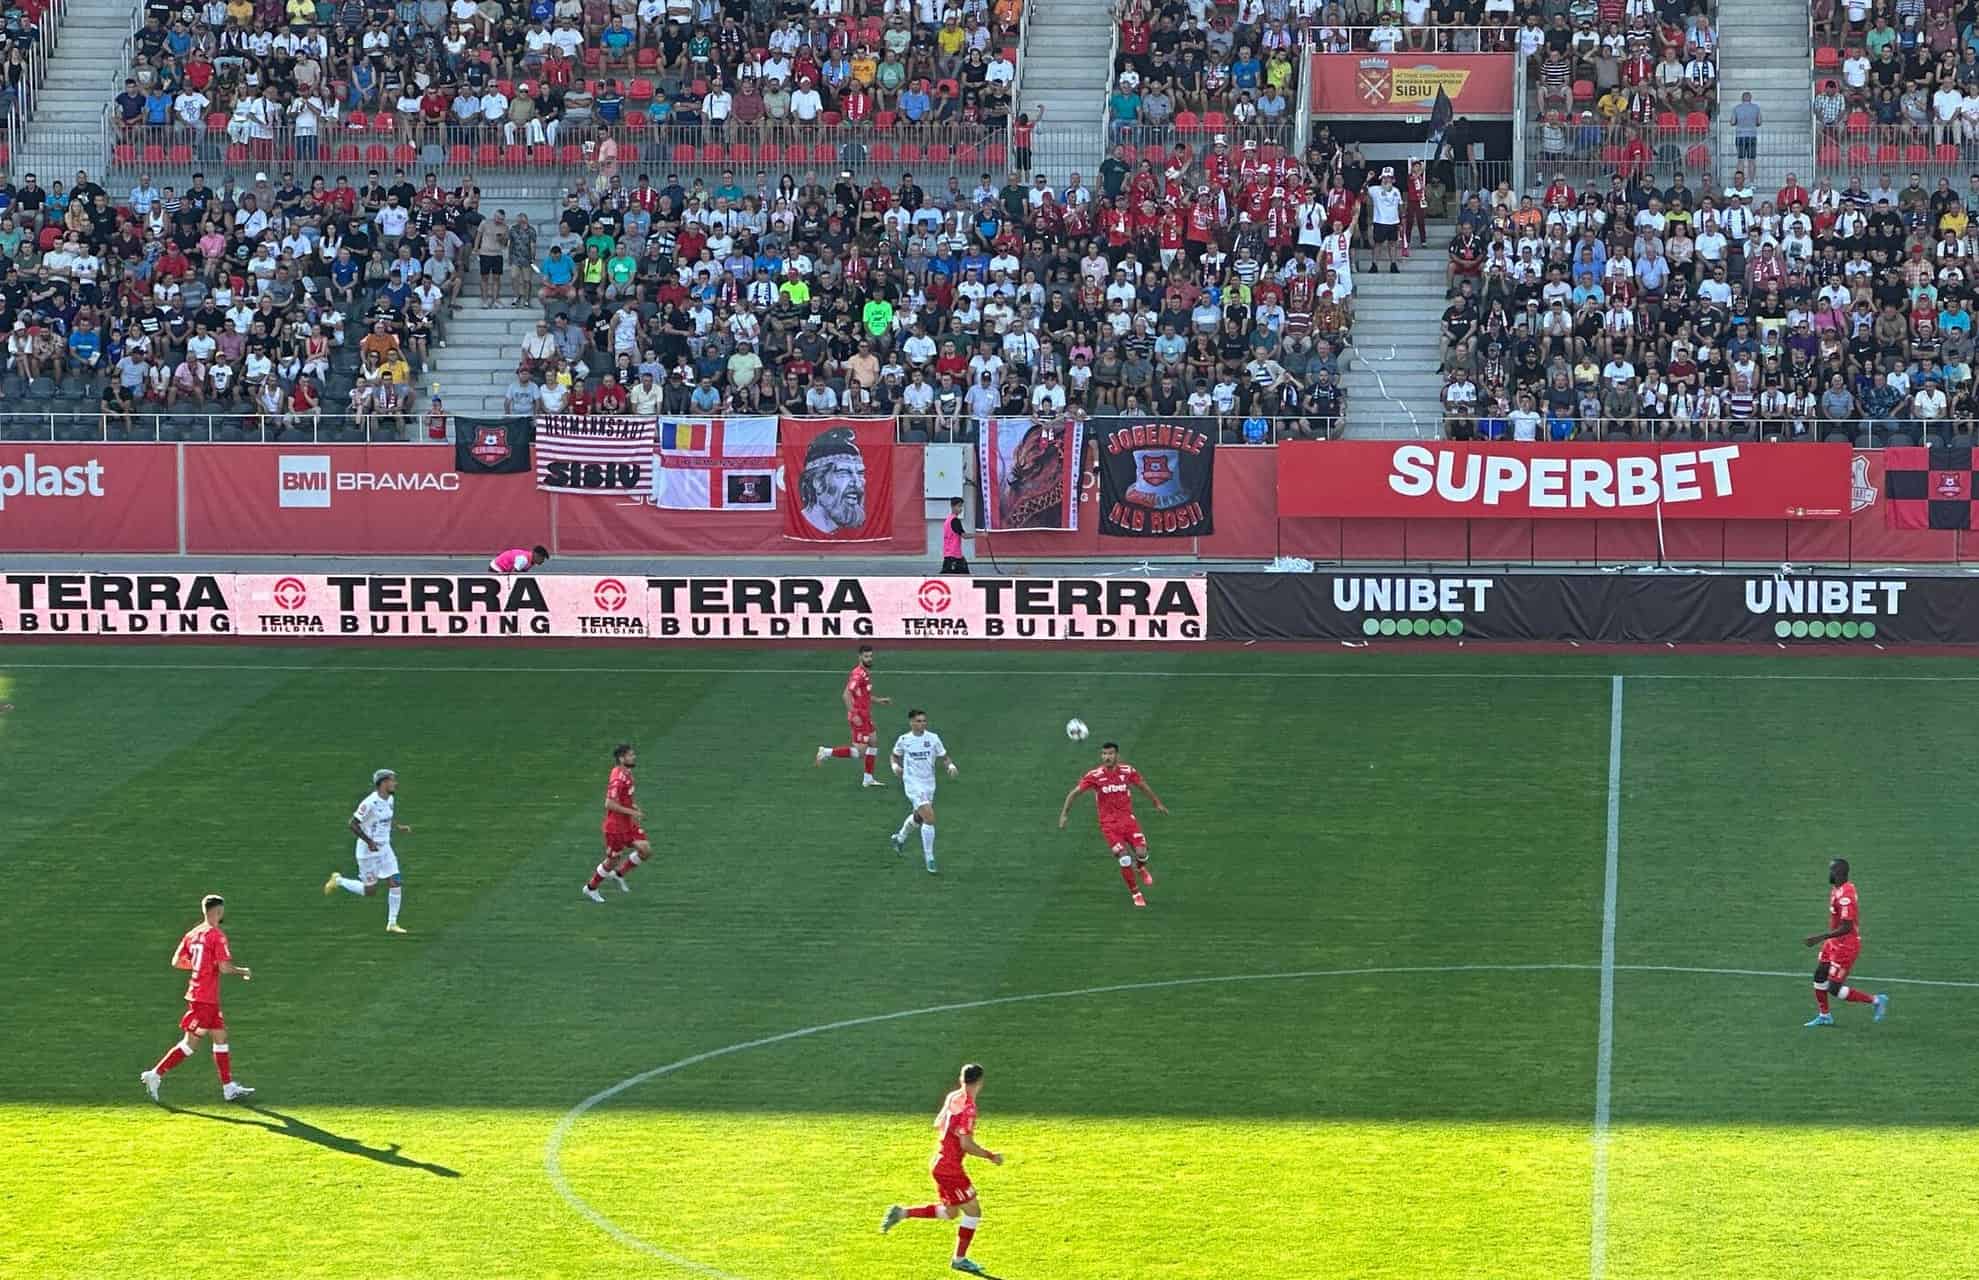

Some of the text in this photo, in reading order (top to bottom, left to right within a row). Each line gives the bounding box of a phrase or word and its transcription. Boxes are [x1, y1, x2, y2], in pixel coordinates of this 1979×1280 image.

[0, 453, 105, 511] plast
[283, 472, 327, 490] BMI
[336, 472, 460, 491] BRAMAC
[1389, 445, 1739, 508] SUPERBET
[7, 575, 229, 610] TERRA
[327, 577, 549, 612] TERRA
[647, 579, 873, 614] TERRA
[972, 580, 1200, 616] TERRA
[1333, 578, 1494, 612] UNIBET
[1746, 580, 1907, 615] UNIBET
[20, 613, 230, 632] BUILDING
[258, 615, 324, 626] TERRA
[341, 615, 550, 634] BUILDING
[577, 616, 643, 627] TERRA
[661, 616, 874, 636] BUILDING
[902, 618, 967, 629] TERRA
[985, 618, 1201, 638] BUILDING
